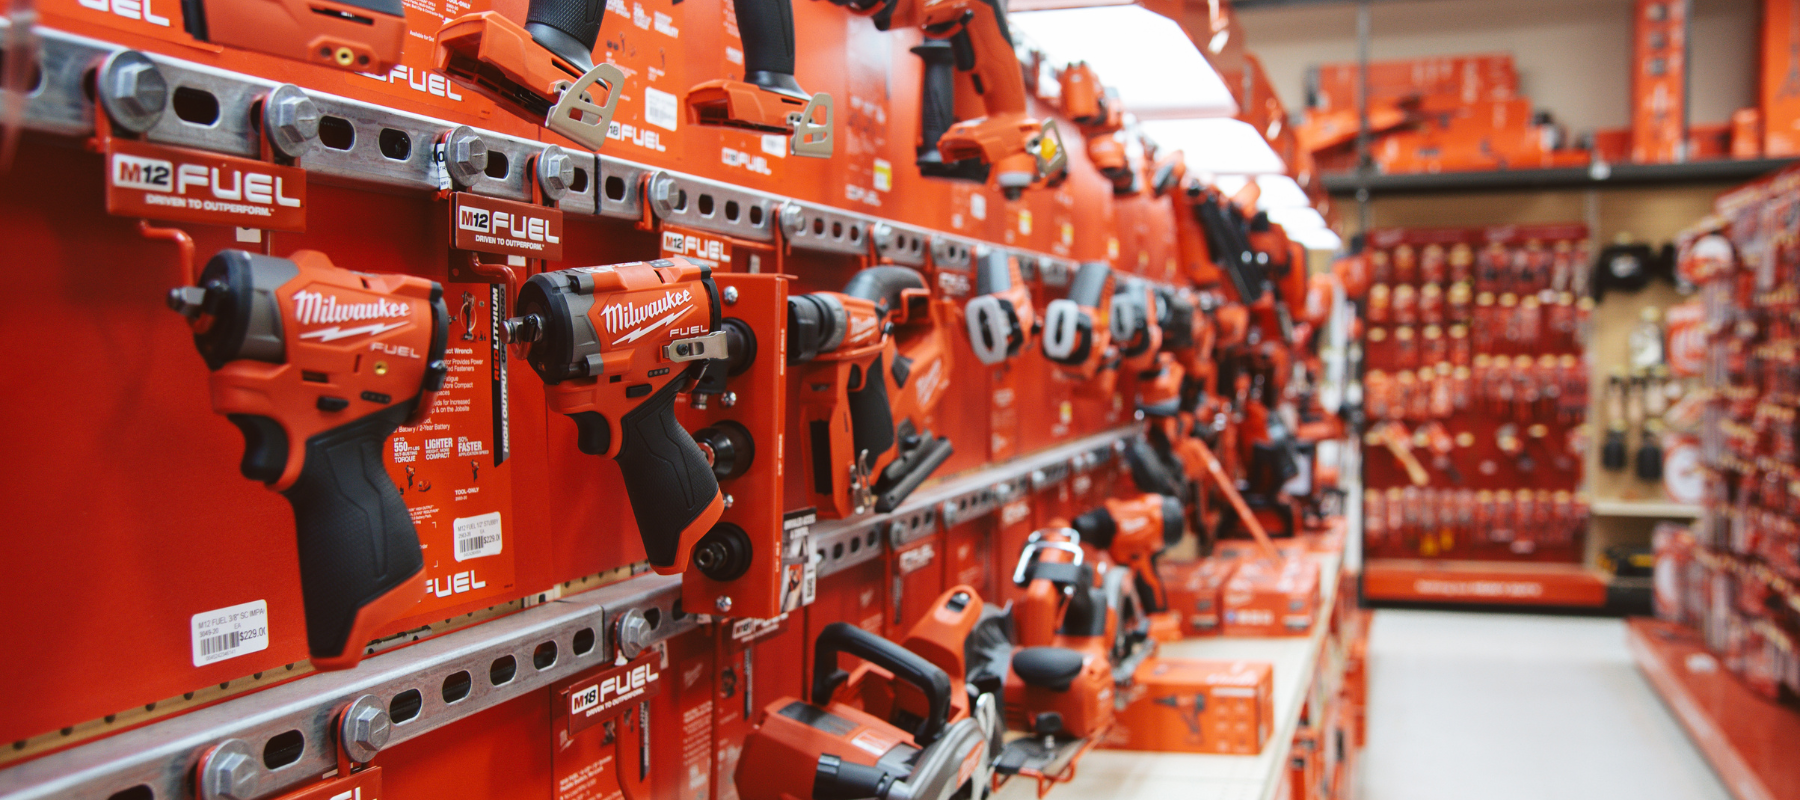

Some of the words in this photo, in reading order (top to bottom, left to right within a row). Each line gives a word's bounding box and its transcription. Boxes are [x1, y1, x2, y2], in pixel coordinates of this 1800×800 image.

[389, 64, 462, 102] FUEL
[621, 124, 666, 152] FUEL
[738, 152, 772, 176] FUEL
[120, 161, 170, 186] M12
[178, 164, 300, 208] FUEL
[146, 194, 186, 208] DRIVEN
[188, 198, 202, 210] TO
[461, 210, 488, 228] M12
[492, 211, 560, 244] FUEL
[476, 234, 496, 244] DRIVEN
[497, 237, 505, 245] TO
[666, 236, 682, 249] M12
[685, 236, 731, 262] FUEL
[292, 290, 411, 325] Milwaukee
[601, 289, 692, 334] Milwaukee
[670, 324, 709, 338] FUEL
[370, 342, 421, 359] FUEL
[394, 442, 408, 452] 550
[425, 438, 453, 450] LIGHTER
[458, 441, 482, 452] FASTER
[455, 487, 479, 495] TOOL-ONLY
[198, 620, 211, 629] M12
[212, 616, 227, 627] FUEL
[229, 613, 239, 622] 3/8"
[240, 611, 248, 620] SC
[574, 689, 596, 710] M18
[600, 663, 659, 702] FUEL
[586, 704, 604, 717] DRIVEN
